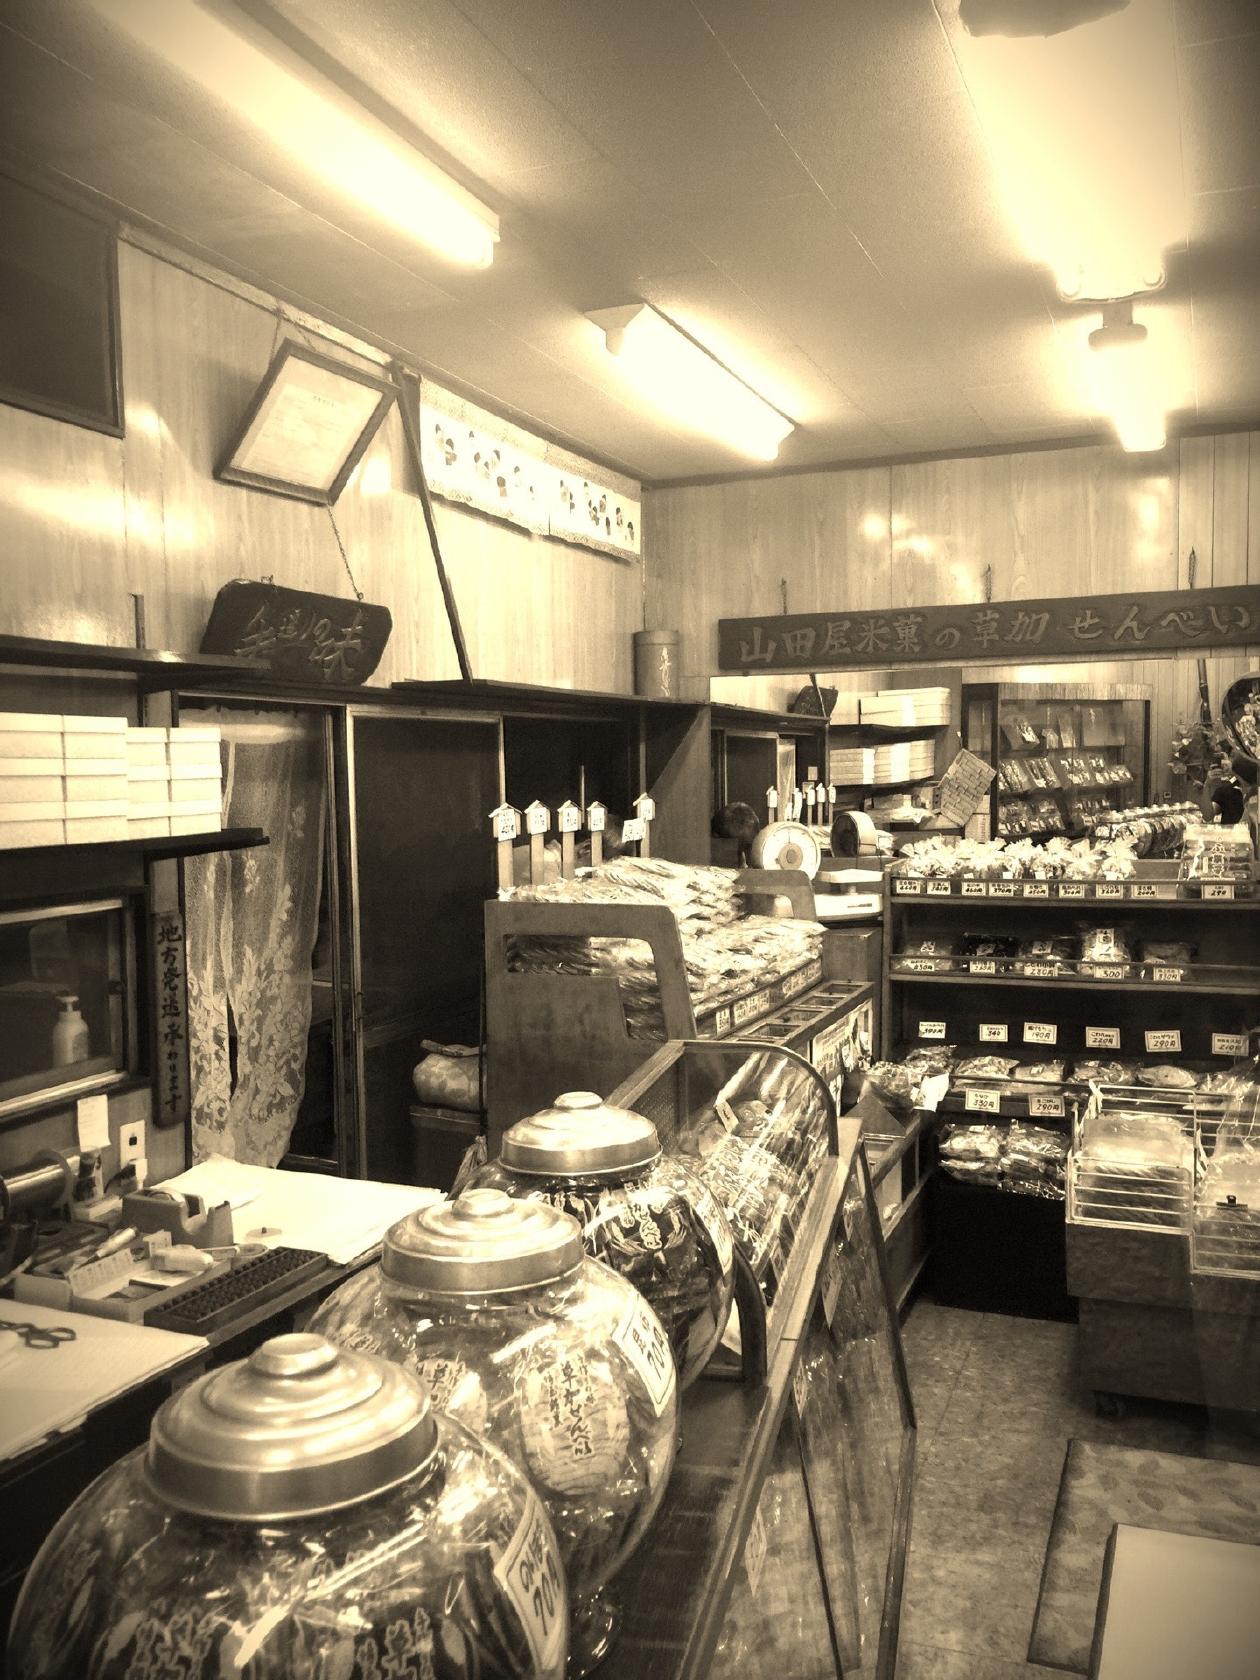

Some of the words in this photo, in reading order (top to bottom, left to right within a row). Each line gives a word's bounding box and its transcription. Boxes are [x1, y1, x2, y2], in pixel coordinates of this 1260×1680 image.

[738, 605, 1250, 664] 山田屋米菓の草加せんべい
[1036, 1103, 1060, 1111] 290円
[560, 1359, 594, 1456] 草加せんべい
